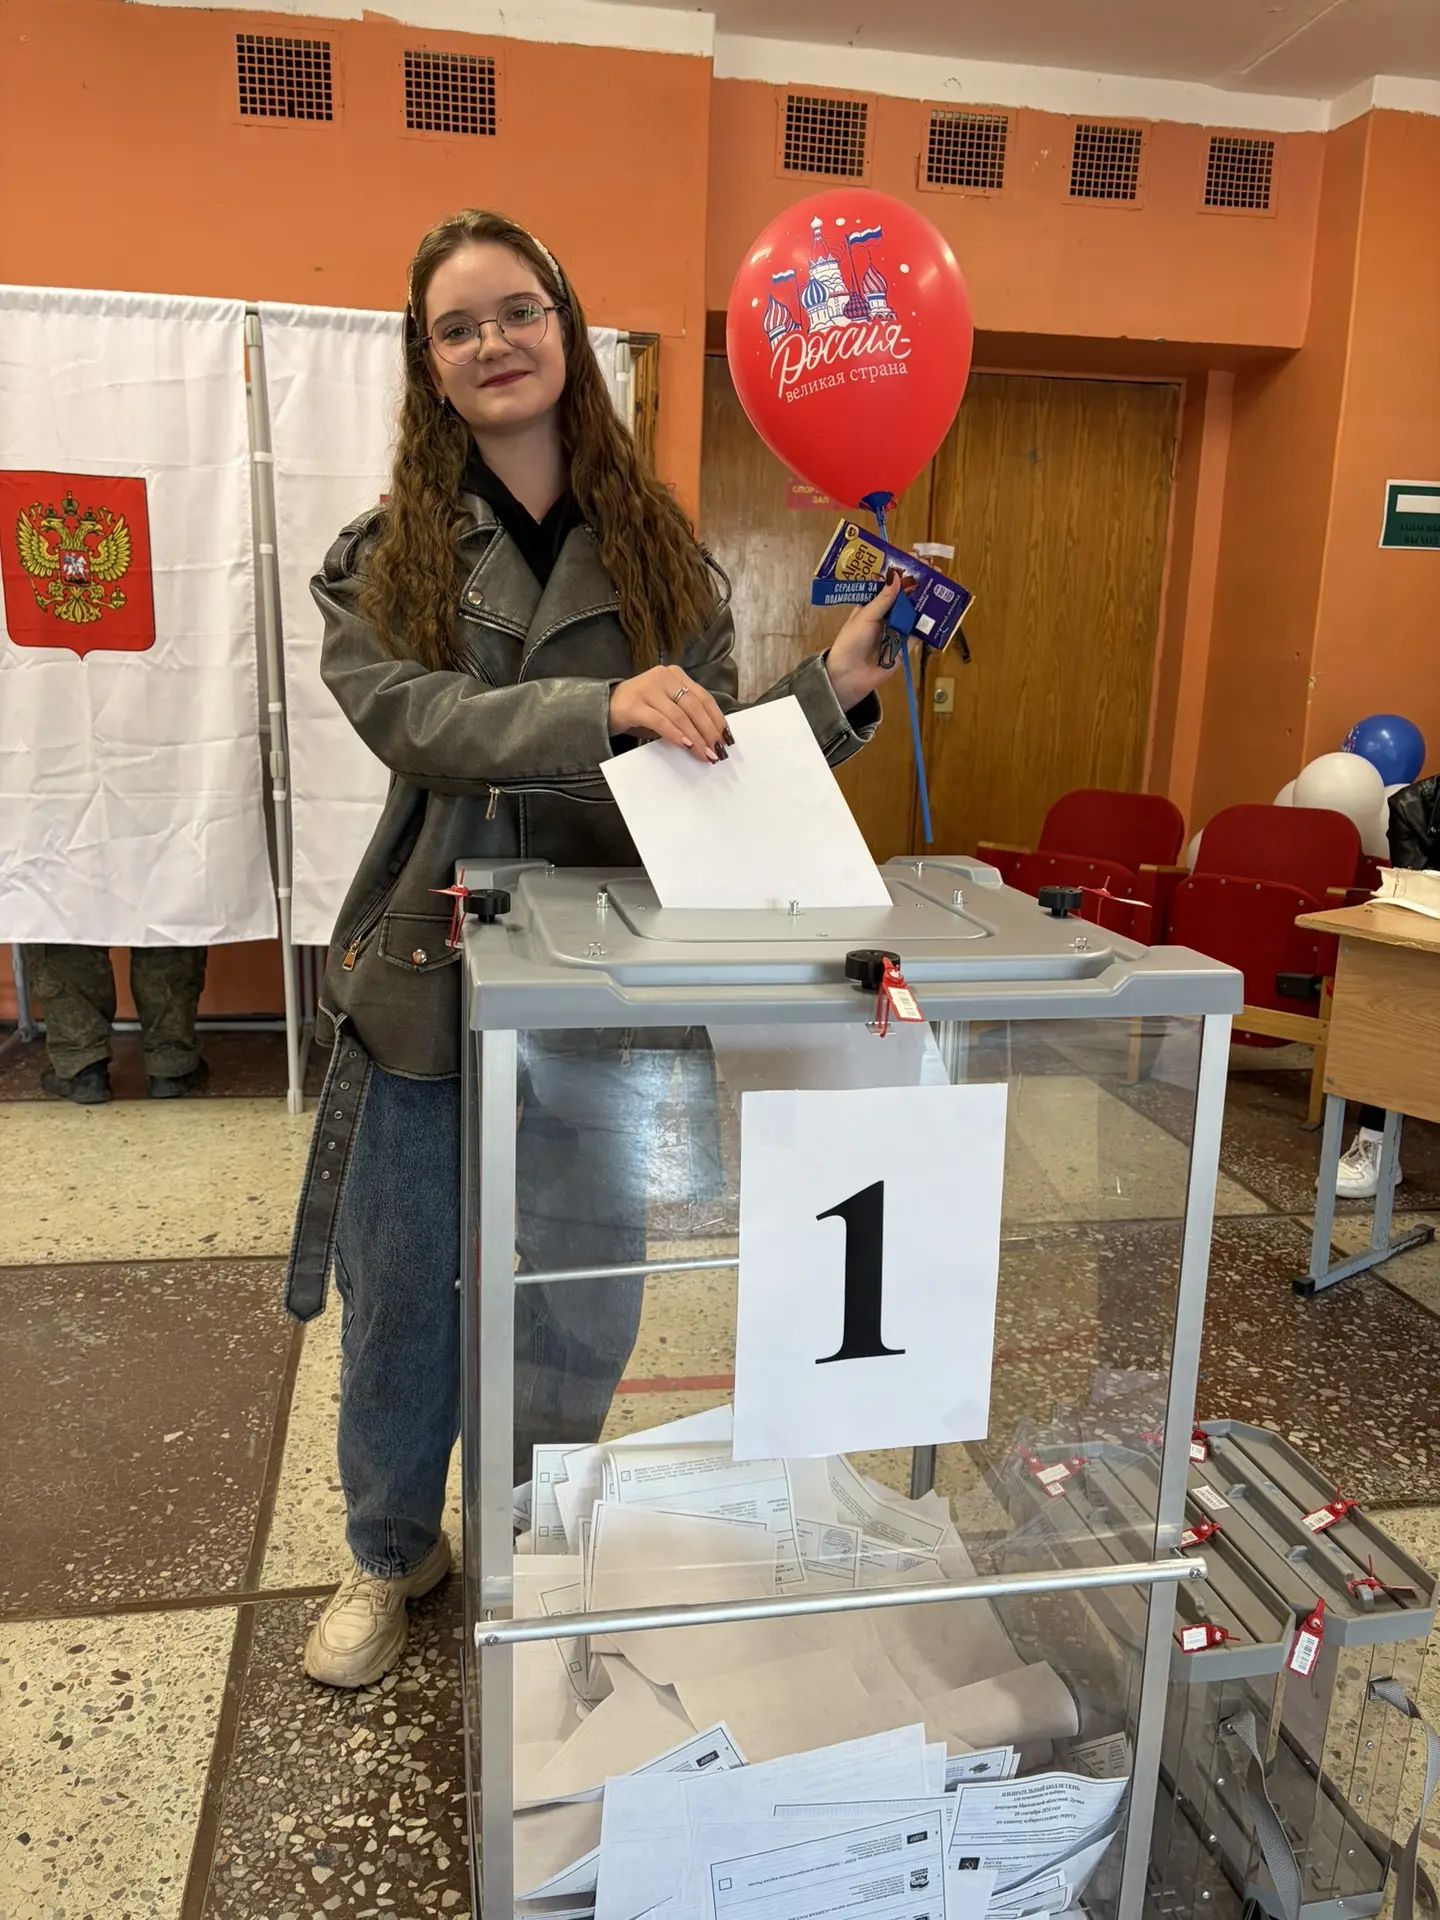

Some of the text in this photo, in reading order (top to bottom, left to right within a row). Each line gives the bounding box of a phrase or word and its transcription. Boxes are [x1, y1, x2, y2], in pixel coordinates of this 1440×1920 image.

[770, 324, 912, 399] Россия
[785, 361, 908, 403] великая страна
[841, 543, 868, 580] Alpen
[834, 582, 878, 593] СЕРДЦЕМ ЗА
[815, 1180, 906, 1365] 1
